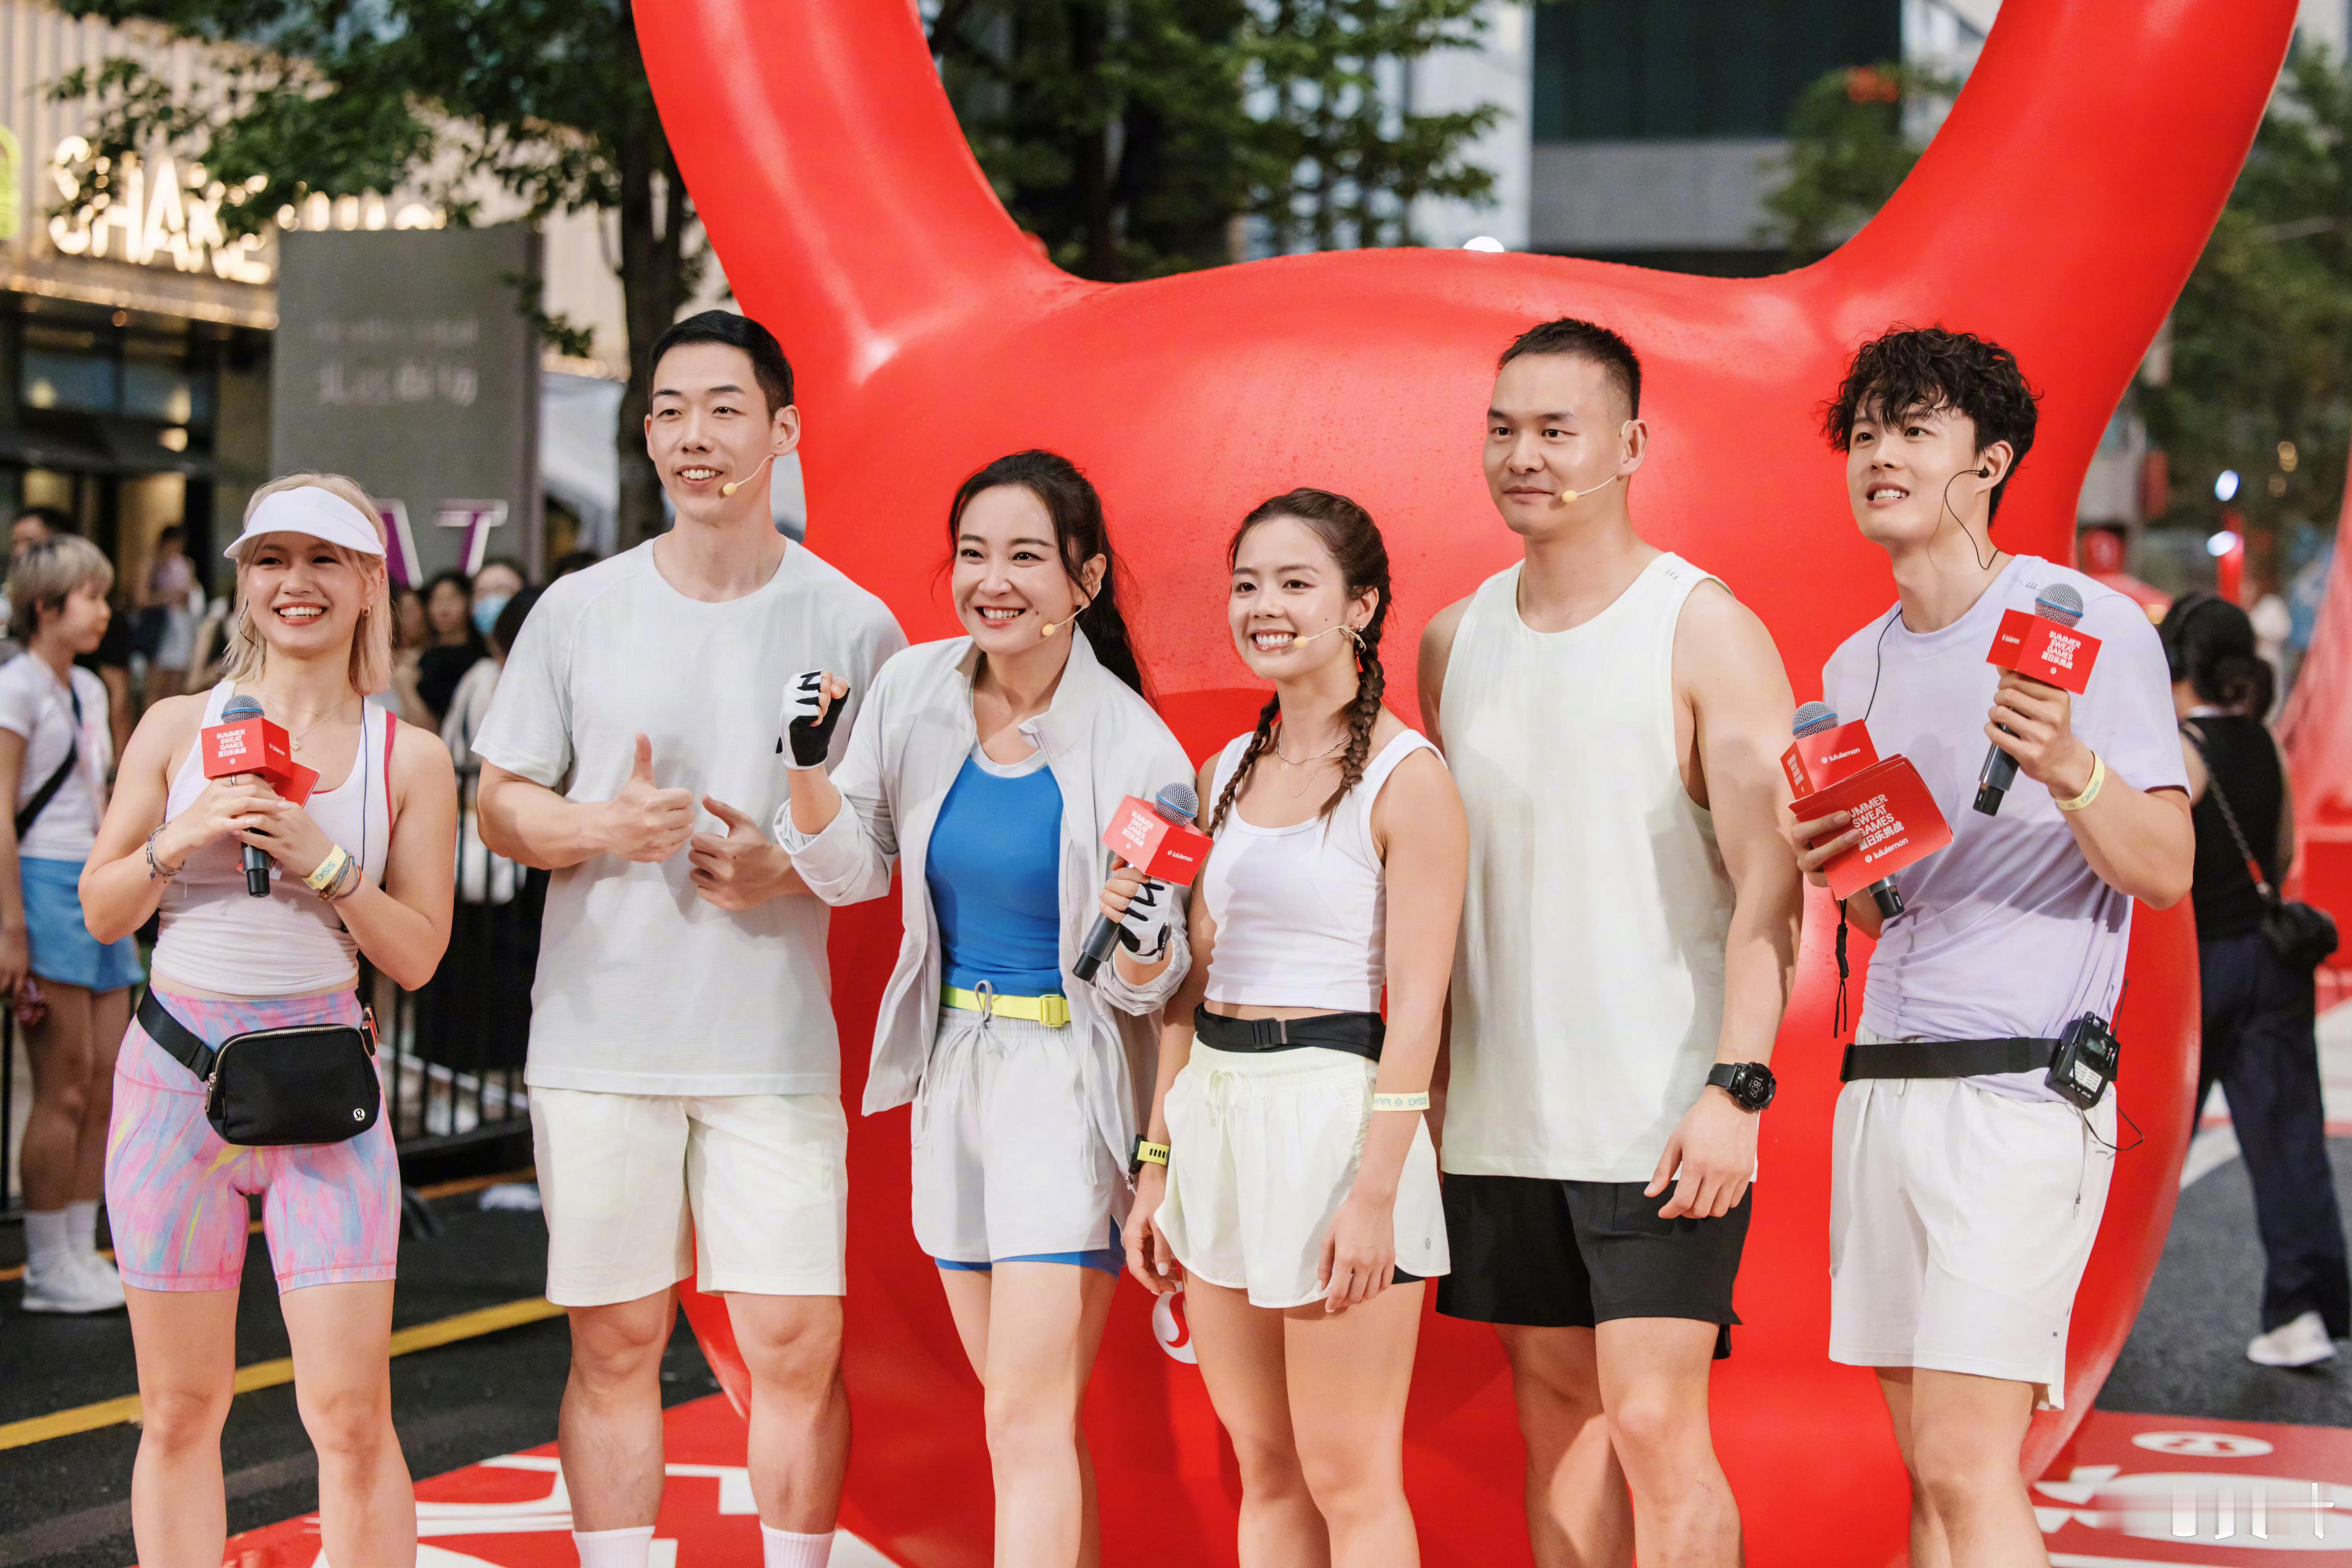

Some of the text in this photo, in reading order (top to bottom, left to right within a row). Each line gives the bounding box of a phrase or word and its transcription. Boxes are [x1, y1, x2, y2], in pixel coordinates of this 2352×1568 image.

[2049, 630, 2081, 649] SUMMER
[2050, 639, 2075, 653] SWEAT
[2047, 646, 2073, 661] GAMES
[216, 729, 245, 739] SUMMER
[220, 735, 242, 744] SWEAT
[220, 741, 243, 750] GAMES
[1829, 748, 1860, 762] lululemon
[1847, 794, 1888, 818] UMMER
[1131, 811, 1154, 830] SUMMER
[1852, 804, 1887, 828] SWEAT
[1127, 824, 1145, 839] GAMES
[1131, 818, 1148, 833] SWEAT
[1873, 838, 1909, 859] lululemon
[1172, 851, 1193, 862] lululemon
[1750, 1076, 1763, 1098] 1809
